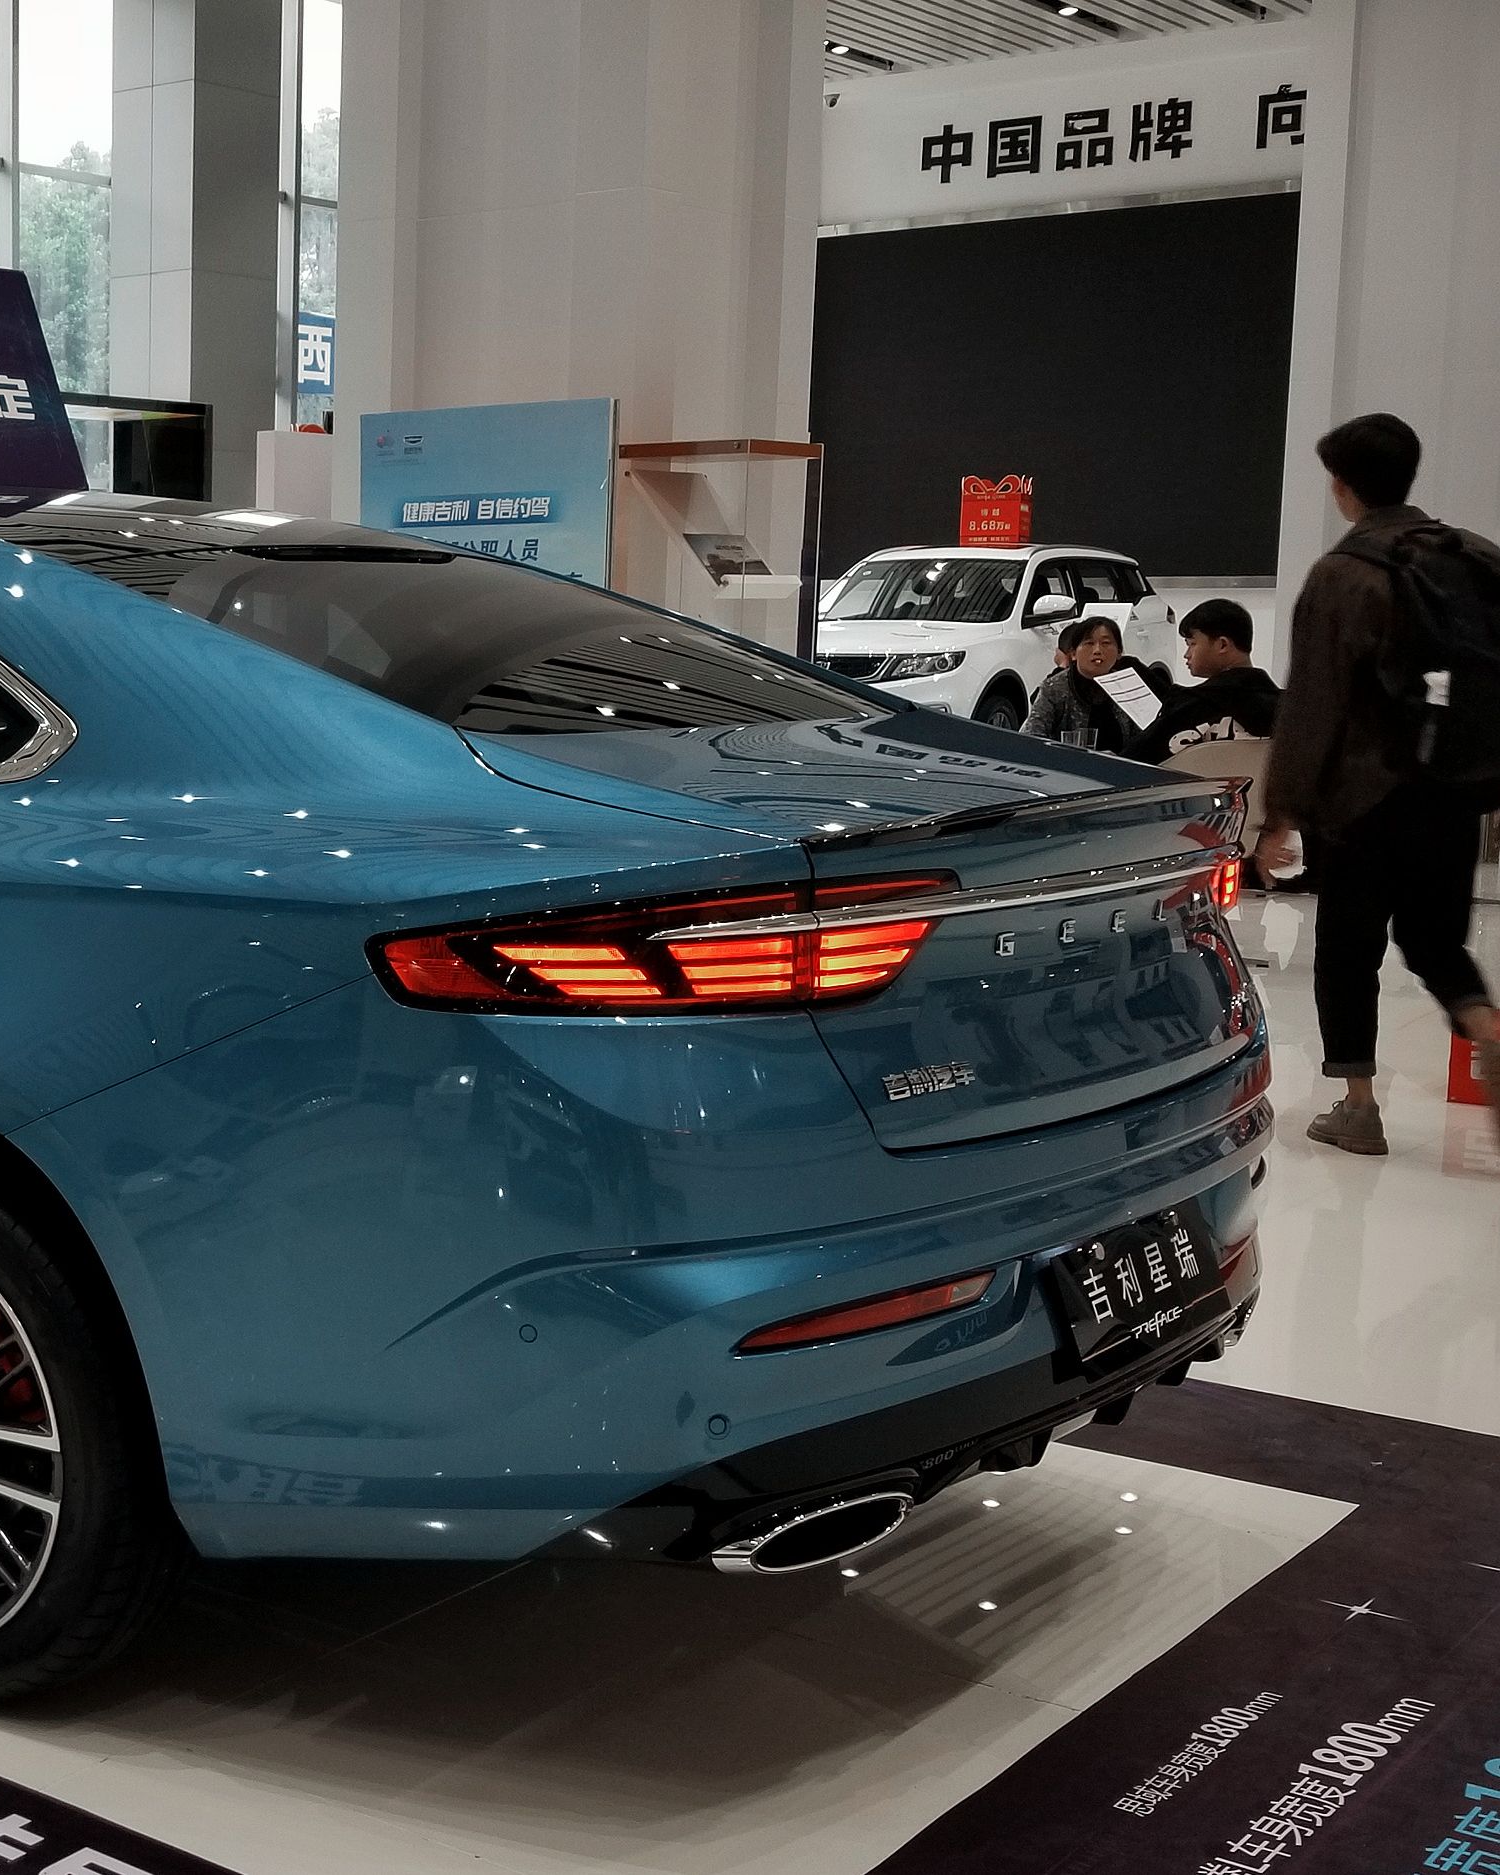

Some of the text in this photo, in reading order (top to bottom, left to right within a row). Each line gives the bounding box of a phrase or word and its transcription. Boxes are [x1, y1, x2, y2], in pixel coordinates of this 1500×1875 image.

[920, 83, 1308, 184] 中国品牌 向
[402, 496, 551, 523] 健康吉利 自信约驾
[444, 538, 539, 562] 职人员
[882, 1061, 975, 1100] 吉利汽车
[1083, 1228, 1200, 1325] 吉利星瑞
[1131, 1305, 1183, 1339] PREFACE
[1113, 1690, 1284, 1818] 思域车身宽度1800mm
